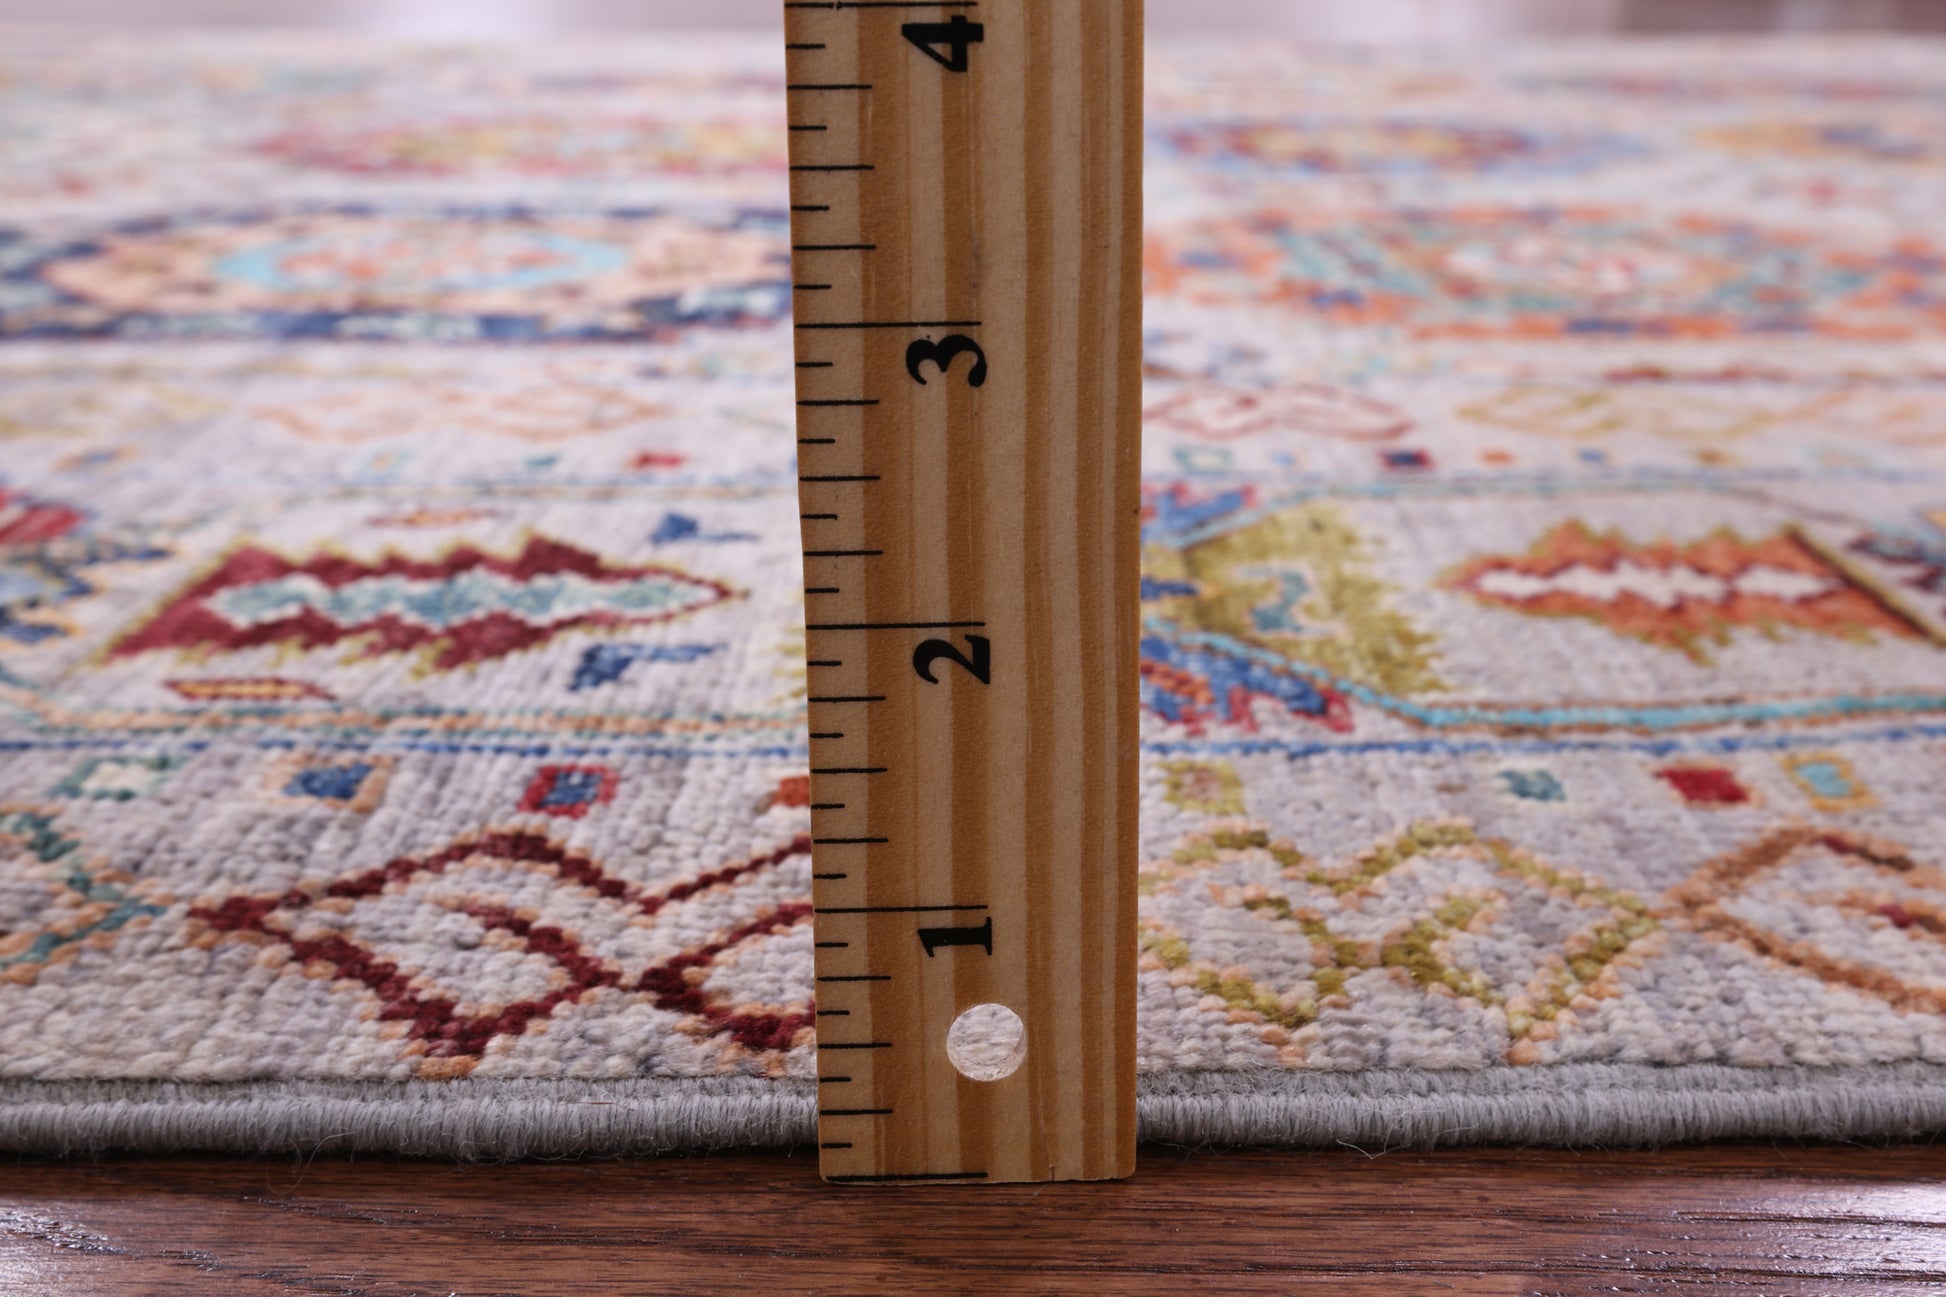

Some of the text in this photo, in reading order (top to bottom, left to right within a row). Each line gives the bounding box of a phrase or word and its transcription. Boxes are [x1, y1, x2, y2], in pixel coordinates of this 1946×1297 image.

[901, 15, 984, 72] 4
[905, 334, 987, 388] 3
[912, 633, 991, 685] 2
[917, 916, 993, 958] 1
